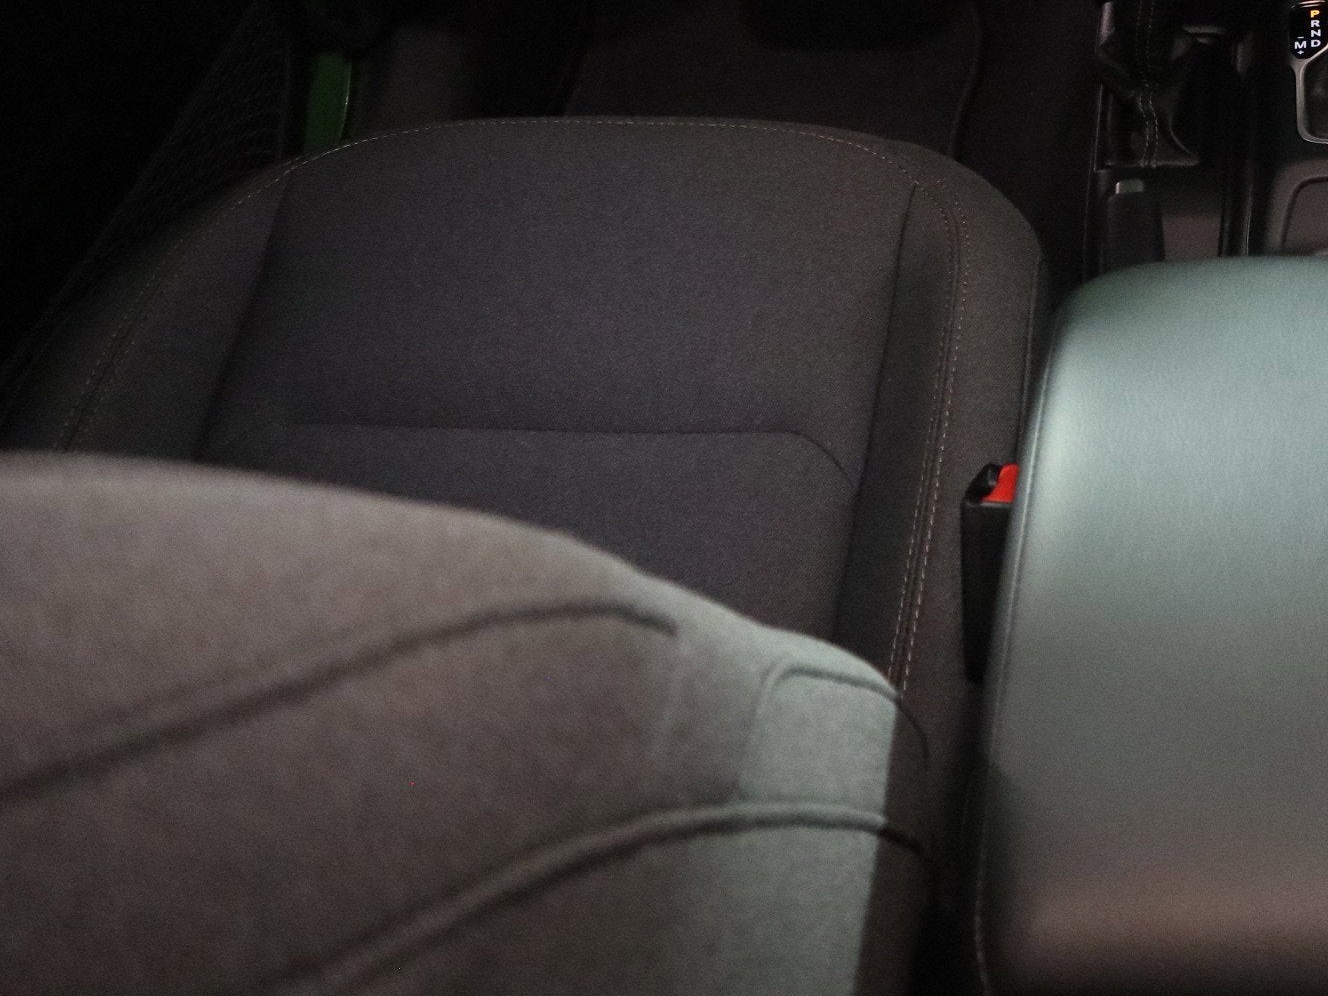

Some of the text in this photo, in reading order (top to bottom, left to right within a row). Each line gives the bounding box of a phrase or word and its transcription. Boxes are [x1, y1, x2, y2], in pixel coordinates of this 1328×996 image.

[1310, 9, 1320, 18] P
[1311, 19, 1321, 27] R
[1310, 29, 1321, 37] N
[1294, 40, 1307, 50] M
[1311, 39, 1321, 48] D
